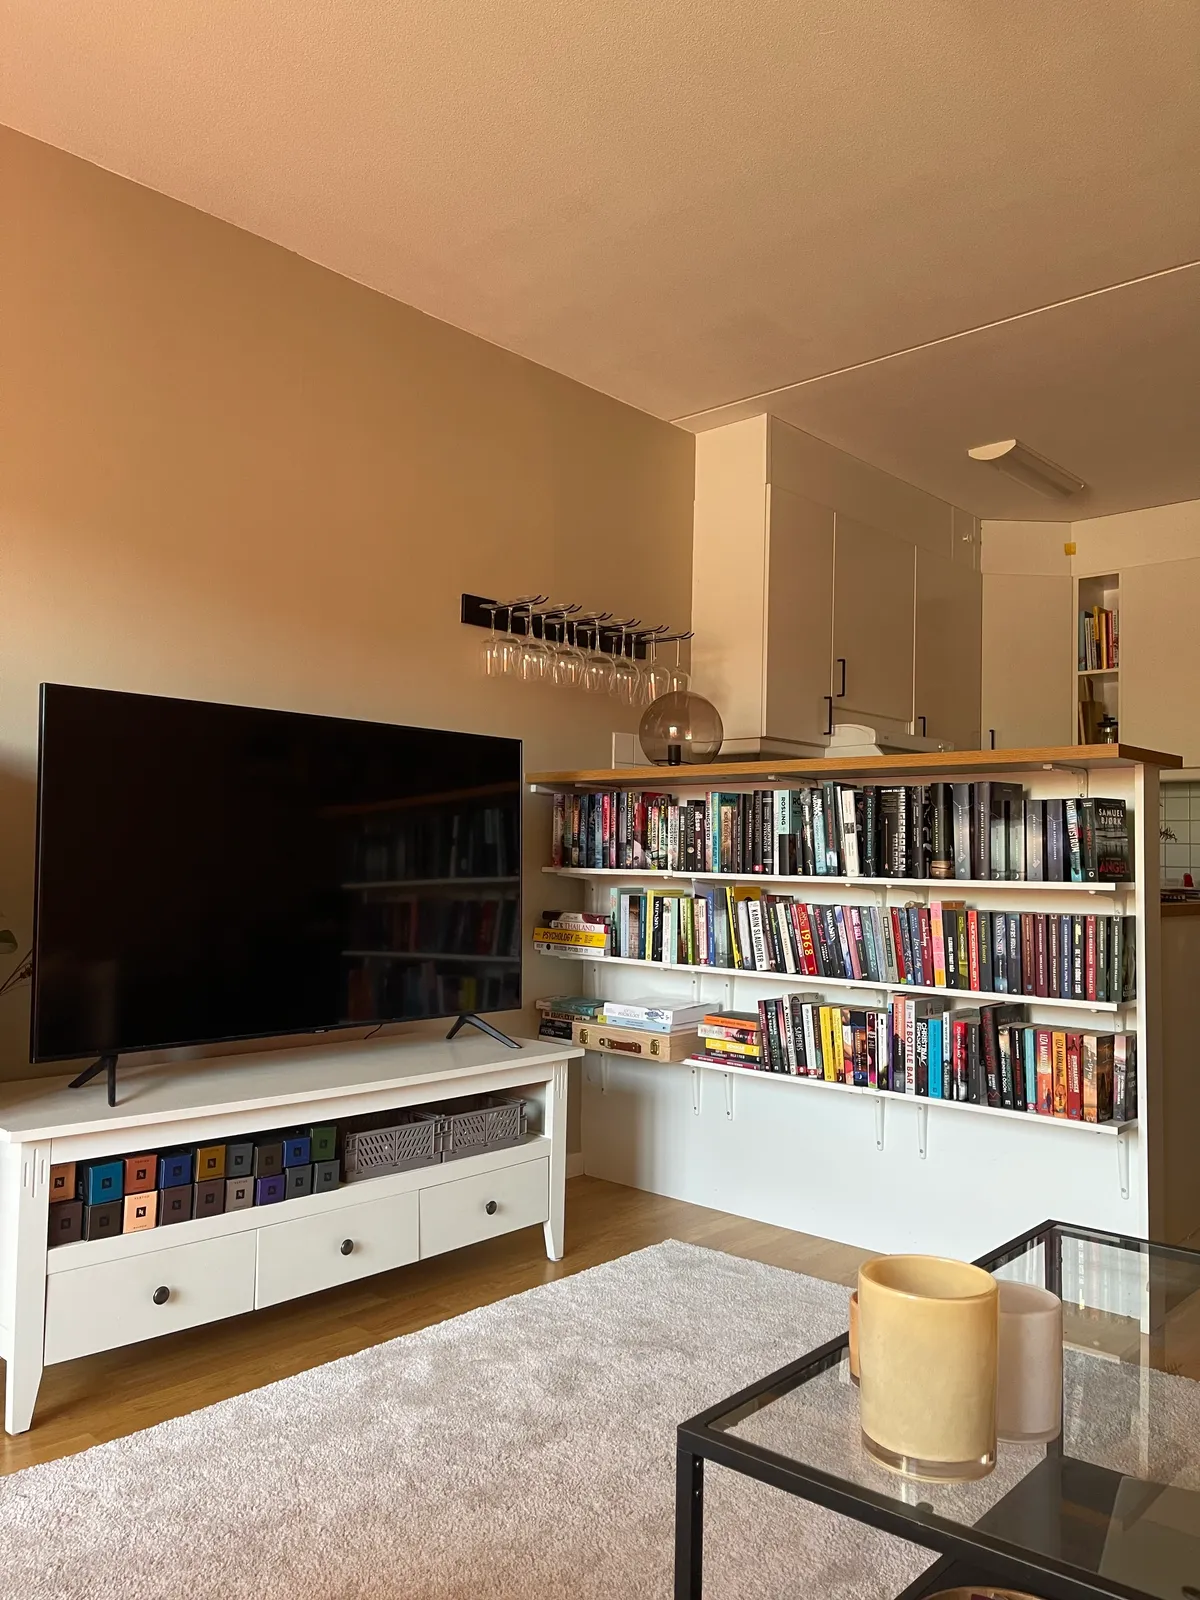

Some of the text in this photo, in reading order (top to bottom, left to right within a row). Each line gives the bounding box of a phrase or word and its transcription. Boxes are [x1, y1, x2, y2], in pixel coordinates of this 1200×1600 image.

[1066, 800, 1078, 823] MOHLIN
[1099, 809, 1123, 817] SAMUEL
[542, 931, 574, 942] PSYCHOLOGY
[565, 922, 595, 932] THAILAND
[751, 909, 764, 963] KARIN SLAUGHTER
[801, 929, 813, 955] 1968
[794, 1026, 803, 1051] SAPIENS
[1040, 1034, 1049, 1074] LIZA MARKLUND
[1056, 1039, 1064, 1077] LIZA MARKLUND
